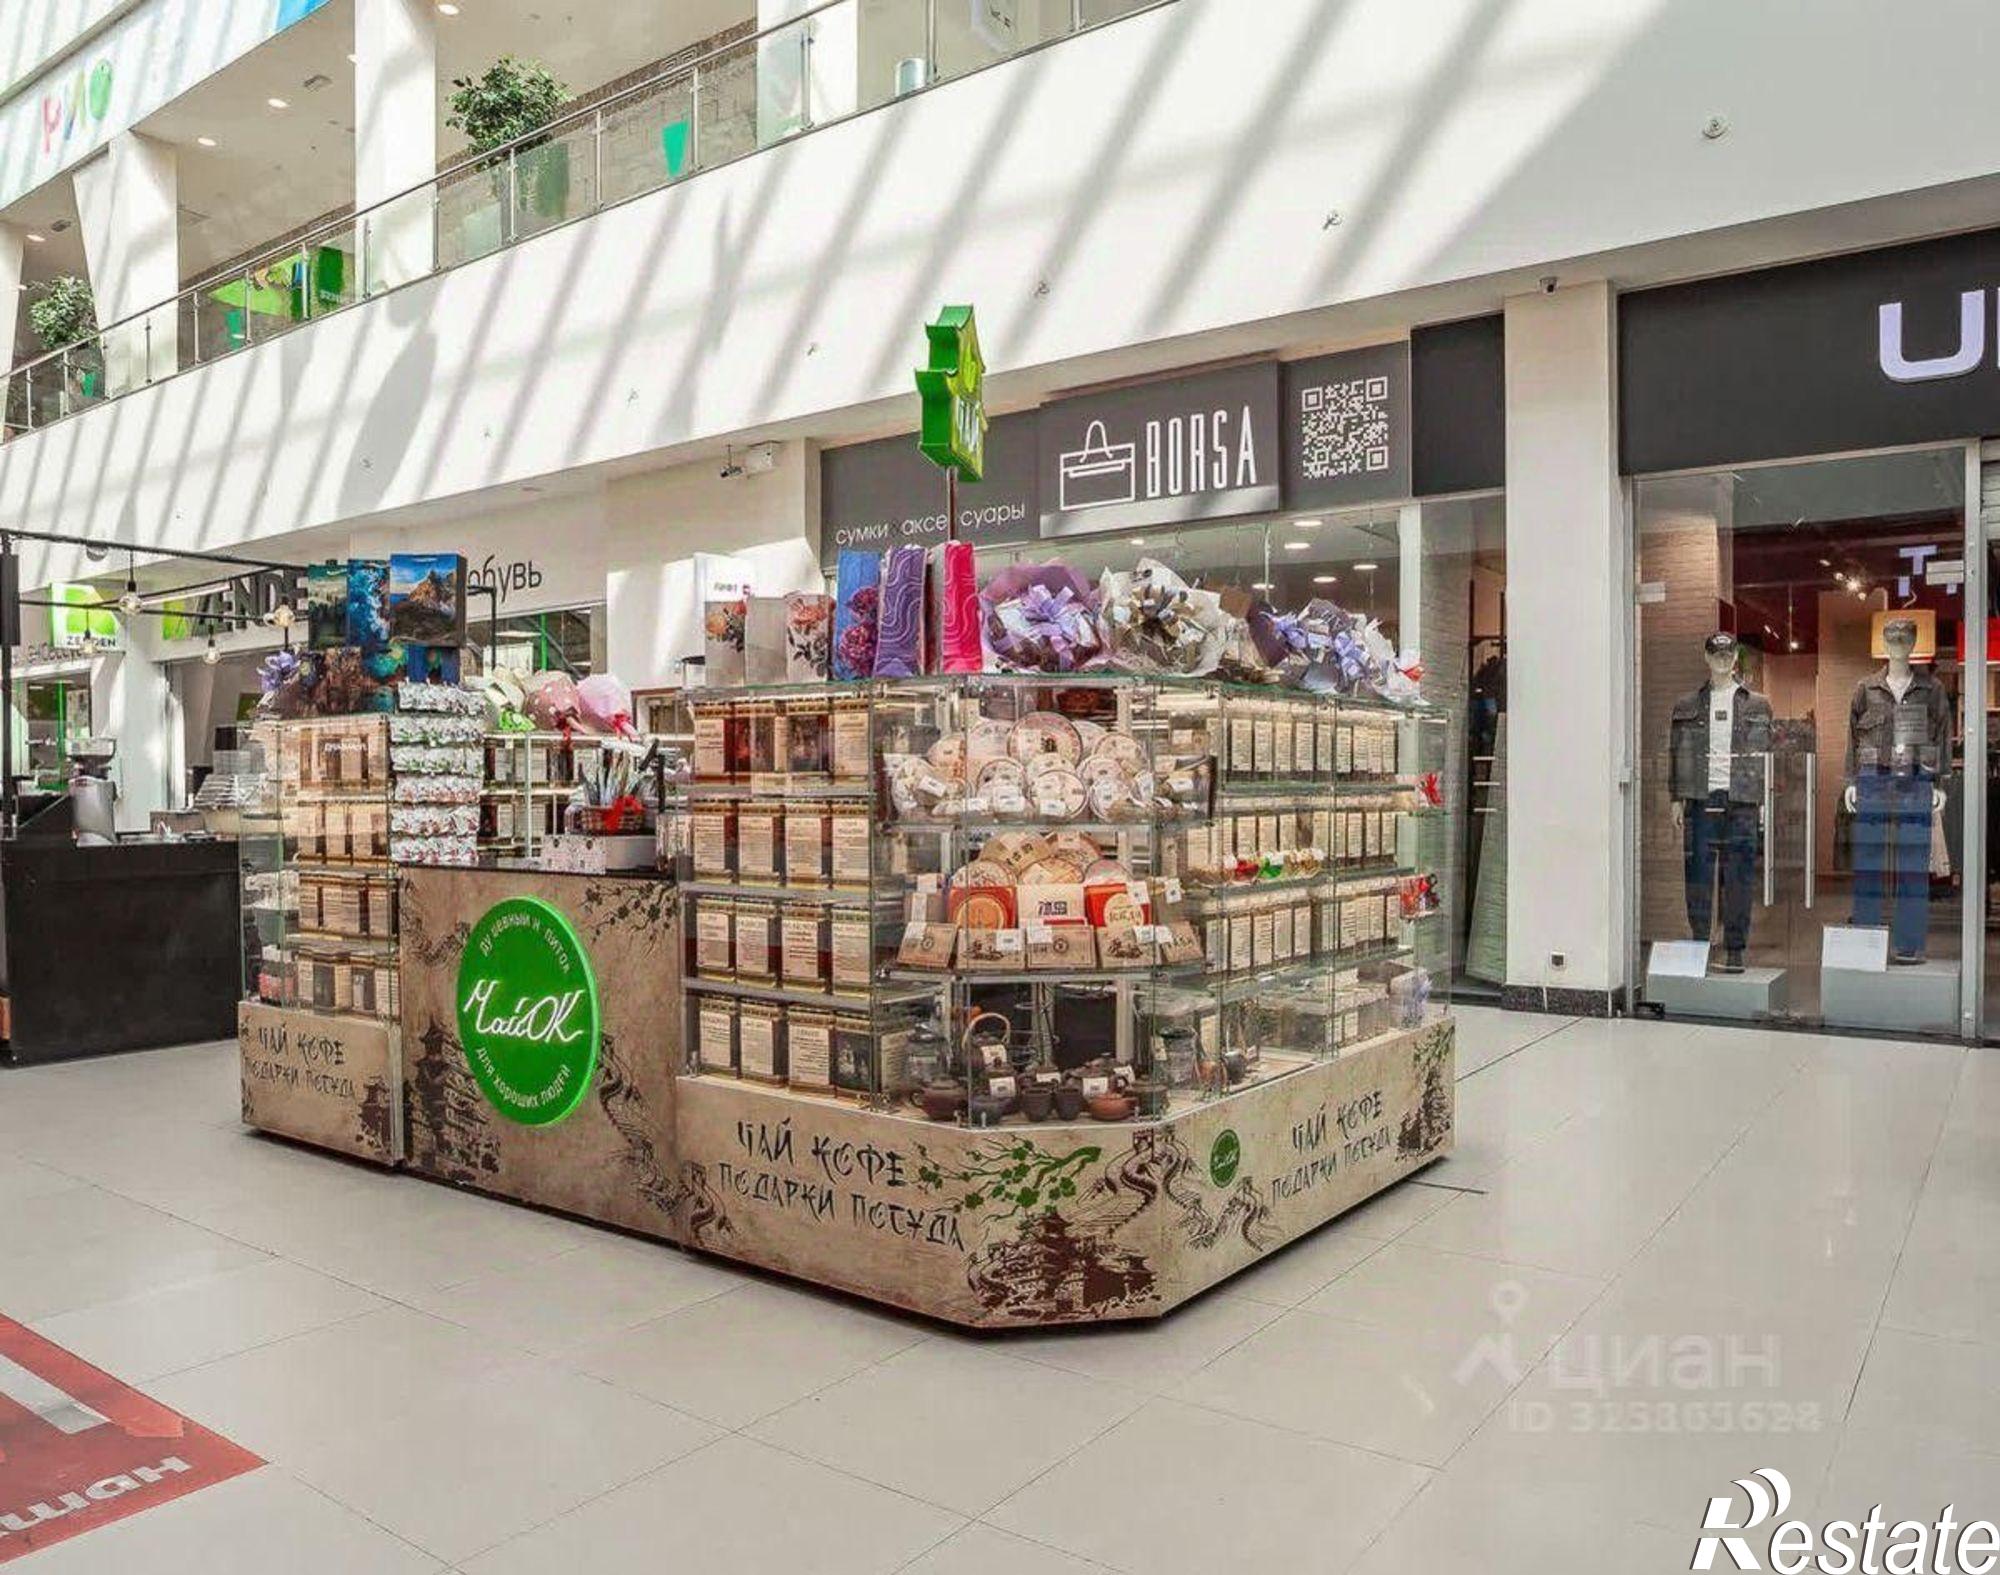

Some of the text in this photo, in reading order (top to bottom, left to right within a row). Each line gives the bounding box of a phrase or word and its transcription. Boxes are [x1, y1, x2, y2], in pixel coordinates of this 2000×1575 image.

[1879, 288, 2000, 382] U
[1146, 405, 1257, 498] BORSA
[836, 503, 1026, 547] сумки аксесуары
[192, 568, 309, 638] ZENDE
[737, 1117, 907, 1187] ЧАЙ КОФЕ
[1292, 1090, 1383, 1155] ЧАЙ КОФЕ
[718, 1162, 965, 1252] ПОДАРКИ ПОСУДА
[1272, 1151, 1338, 1208] ПОДАРКИ
[0, 1456, 192, 1539] шан
